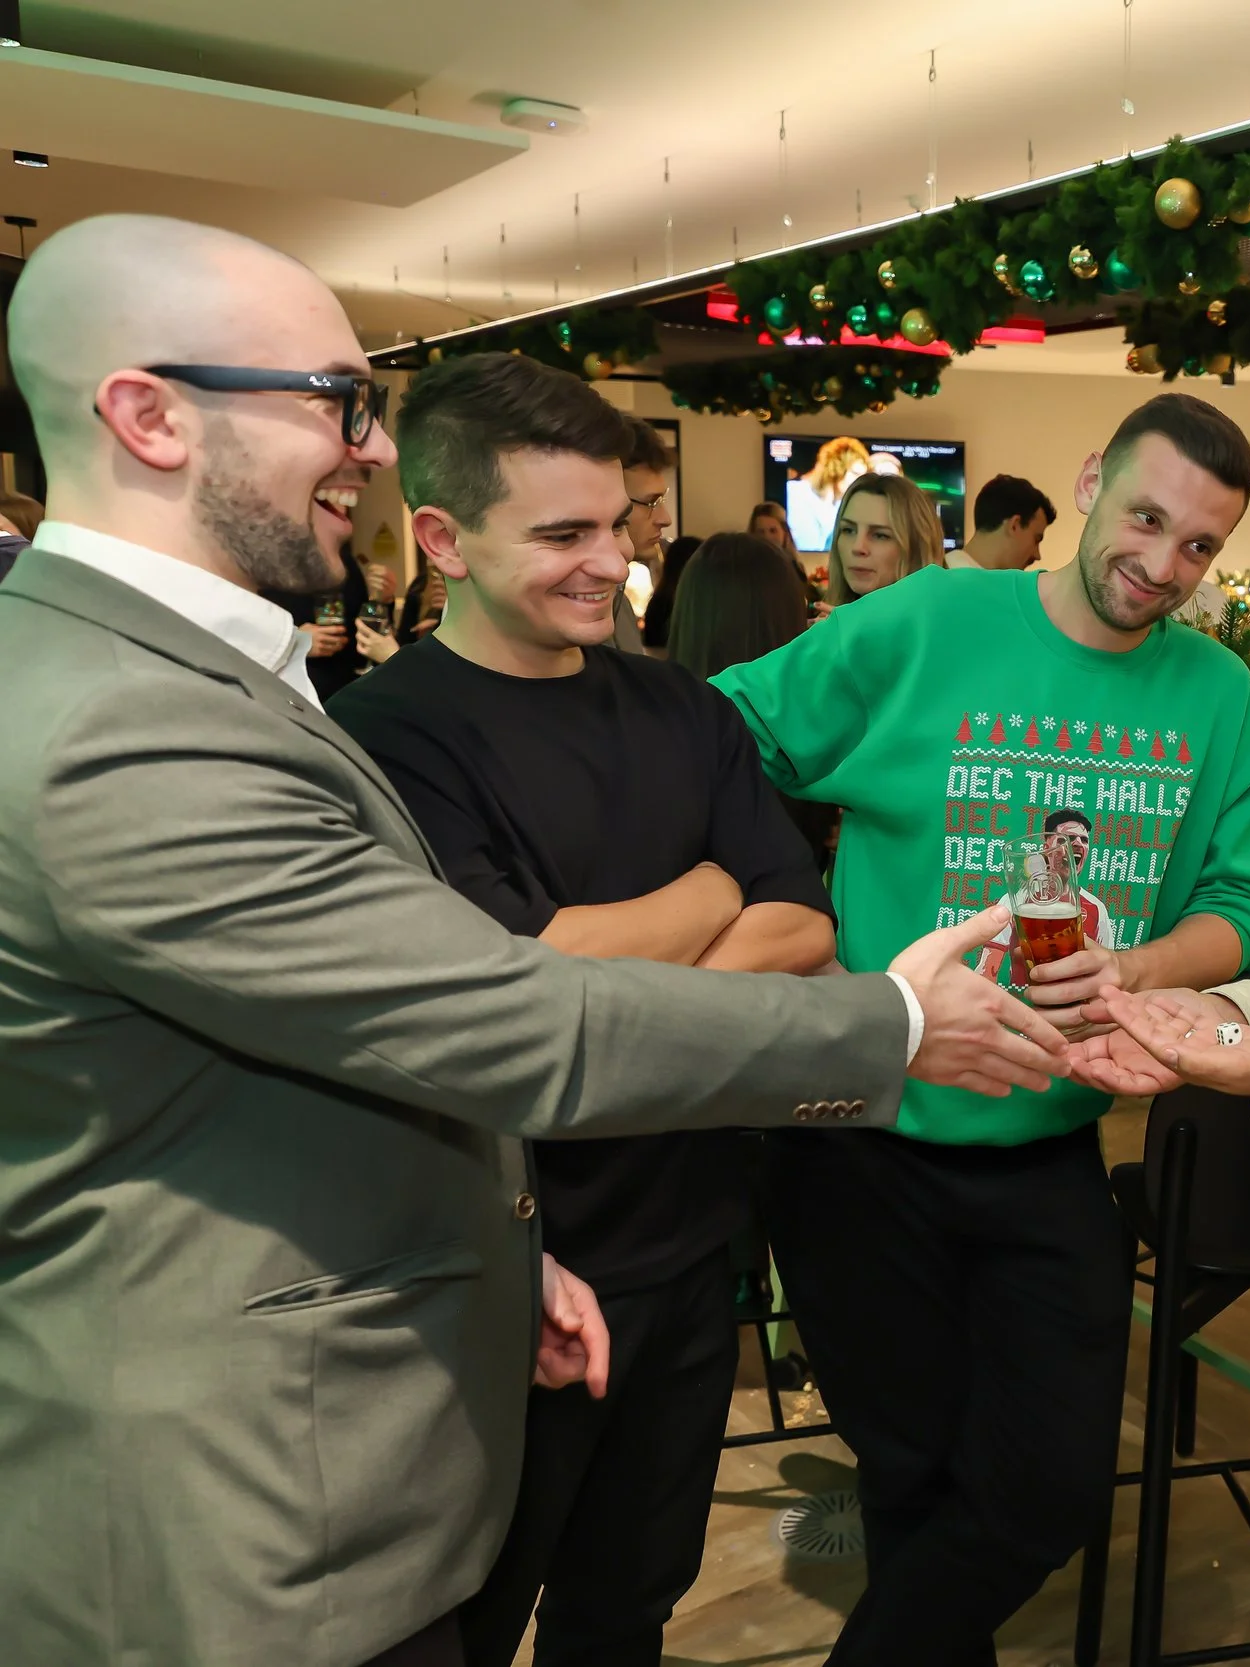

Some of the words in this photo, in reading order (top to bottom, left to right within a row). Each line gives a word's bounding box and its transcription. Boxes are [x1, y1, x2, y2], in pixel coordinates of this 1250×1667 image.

[946, 765, 1013, 801] DEC
[1025, 770, 1087, 809] THE
[1096, 778, 1191, 818] HALLS
[944, 800, 1010, 836] DEC
[944, 836, 1014, 873] DEC
[1088, 847, 1171, 884] HALL
[940, 872, 1003, 908] DEC
